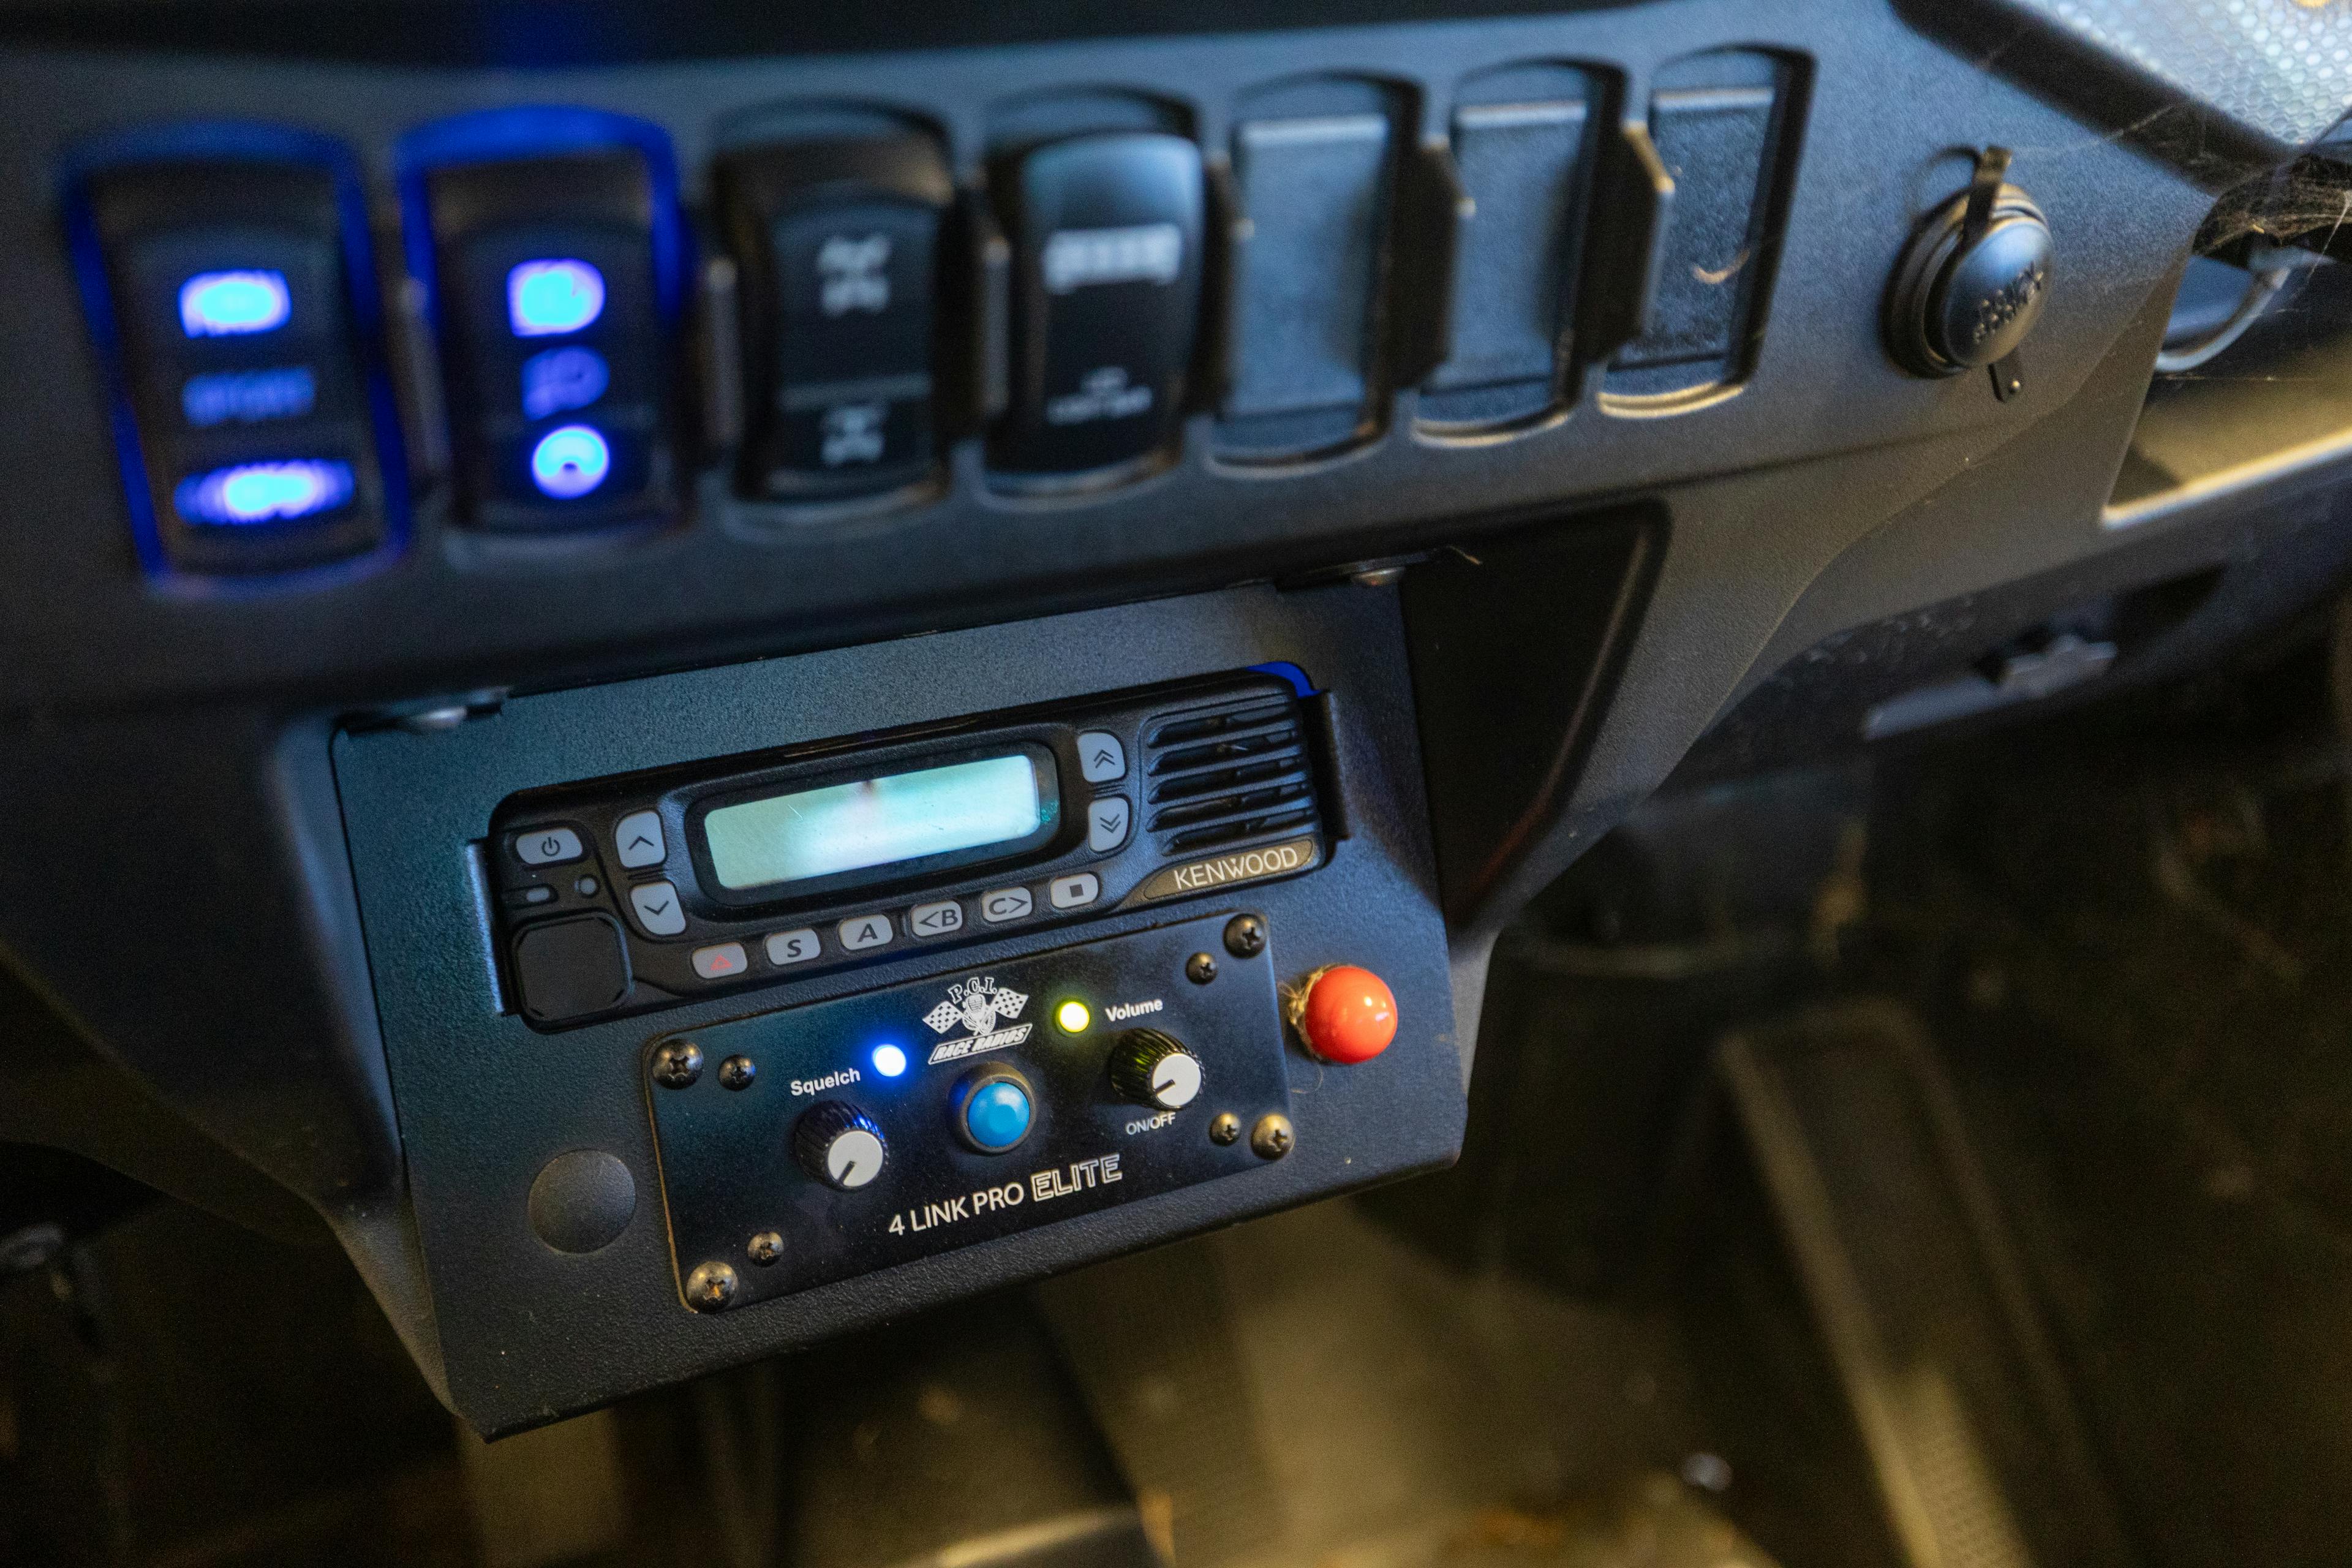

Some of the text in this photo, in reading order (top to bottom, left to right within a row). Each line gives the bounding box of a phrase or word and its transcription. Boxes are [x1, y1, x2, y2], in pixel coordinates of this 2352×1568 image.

[1173, 846, 1298, 891] KENWOOD
[858, 924, 878, 942] A
[786, 939, 802, 958] S
[1105, 999, 1164, 1022] Volume
[932, 1027, 1028, 1061] RACE RADIOS
[790, 1068, 861, 1097] Squelch
[1125, 1112, 1177, 1136] ON/OFF
[888, 1153, 1123, 1236] 4 LINK PRO ELITE
